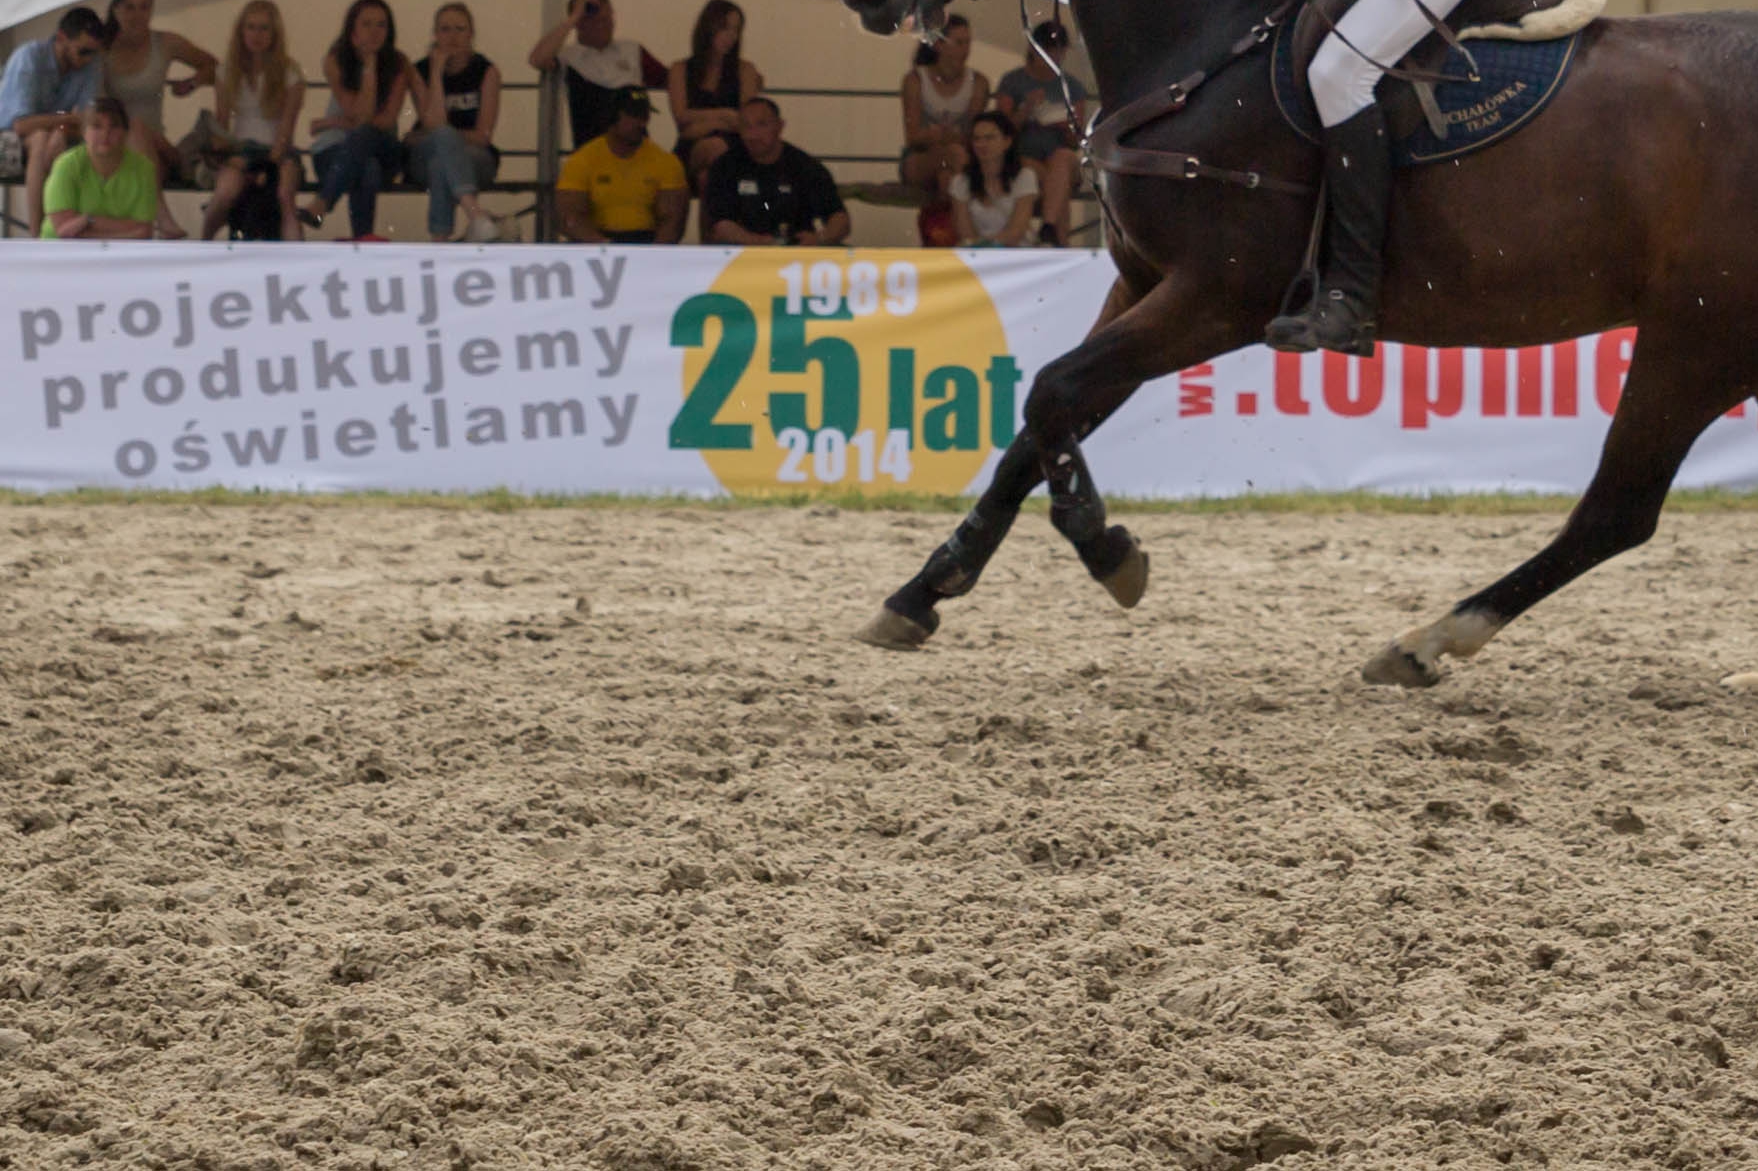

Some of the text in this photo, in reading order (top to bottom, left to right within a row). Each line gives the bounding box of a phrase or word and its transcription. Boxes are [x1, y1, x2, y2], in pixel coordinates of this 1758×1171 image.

[20, 256, 627, 360] projektujemy
[780, 261, 919, 316] 1989
[42, 324, 633, 427] produkujemy
[668, 293, 1022, 453] 25 lat
[114, 392, 640, 479] oświetlamy
[777, 428, 913, 483] 2014
